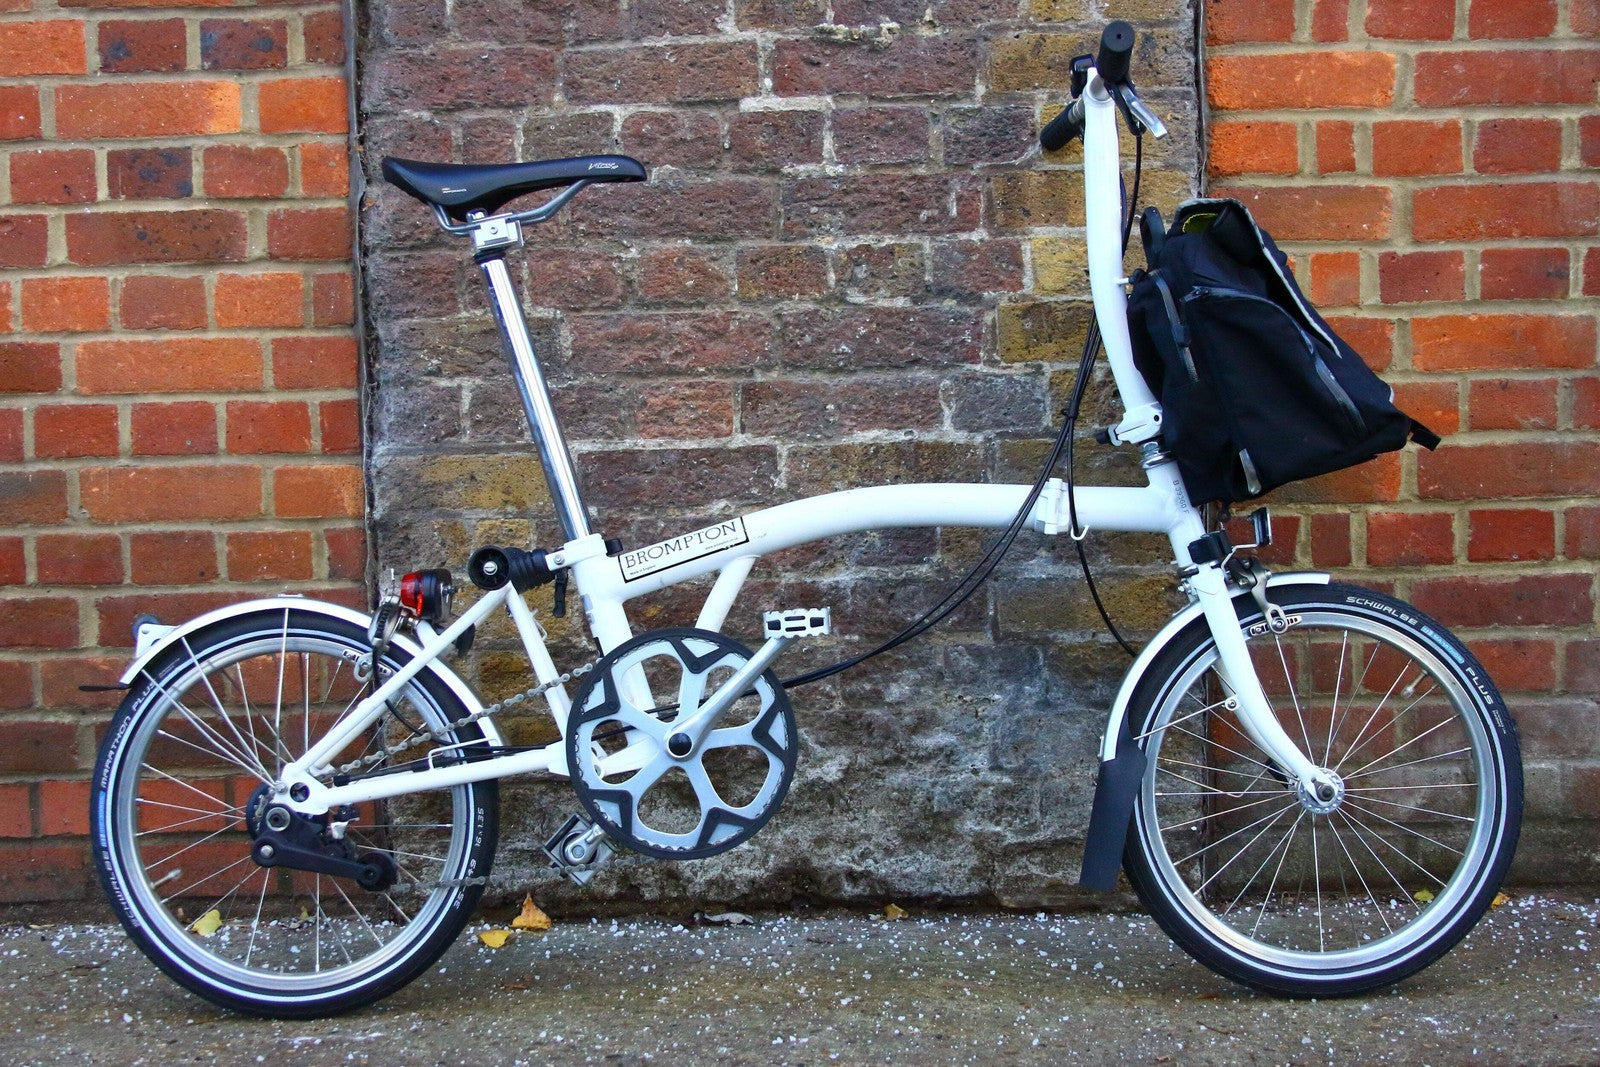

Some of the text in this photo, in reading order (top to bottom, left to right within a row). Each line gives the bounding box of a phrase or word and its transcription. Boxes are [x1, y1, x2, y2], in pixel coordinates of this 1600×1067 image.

[625, 521, 737, 568] BROMPTON
[1345, 596, 1419, 626] SCHWALBE
[1465, 666, 1494, 705] PLUS
[100, 681, 156, 927] SCHWALBE MARATHON PLUS
